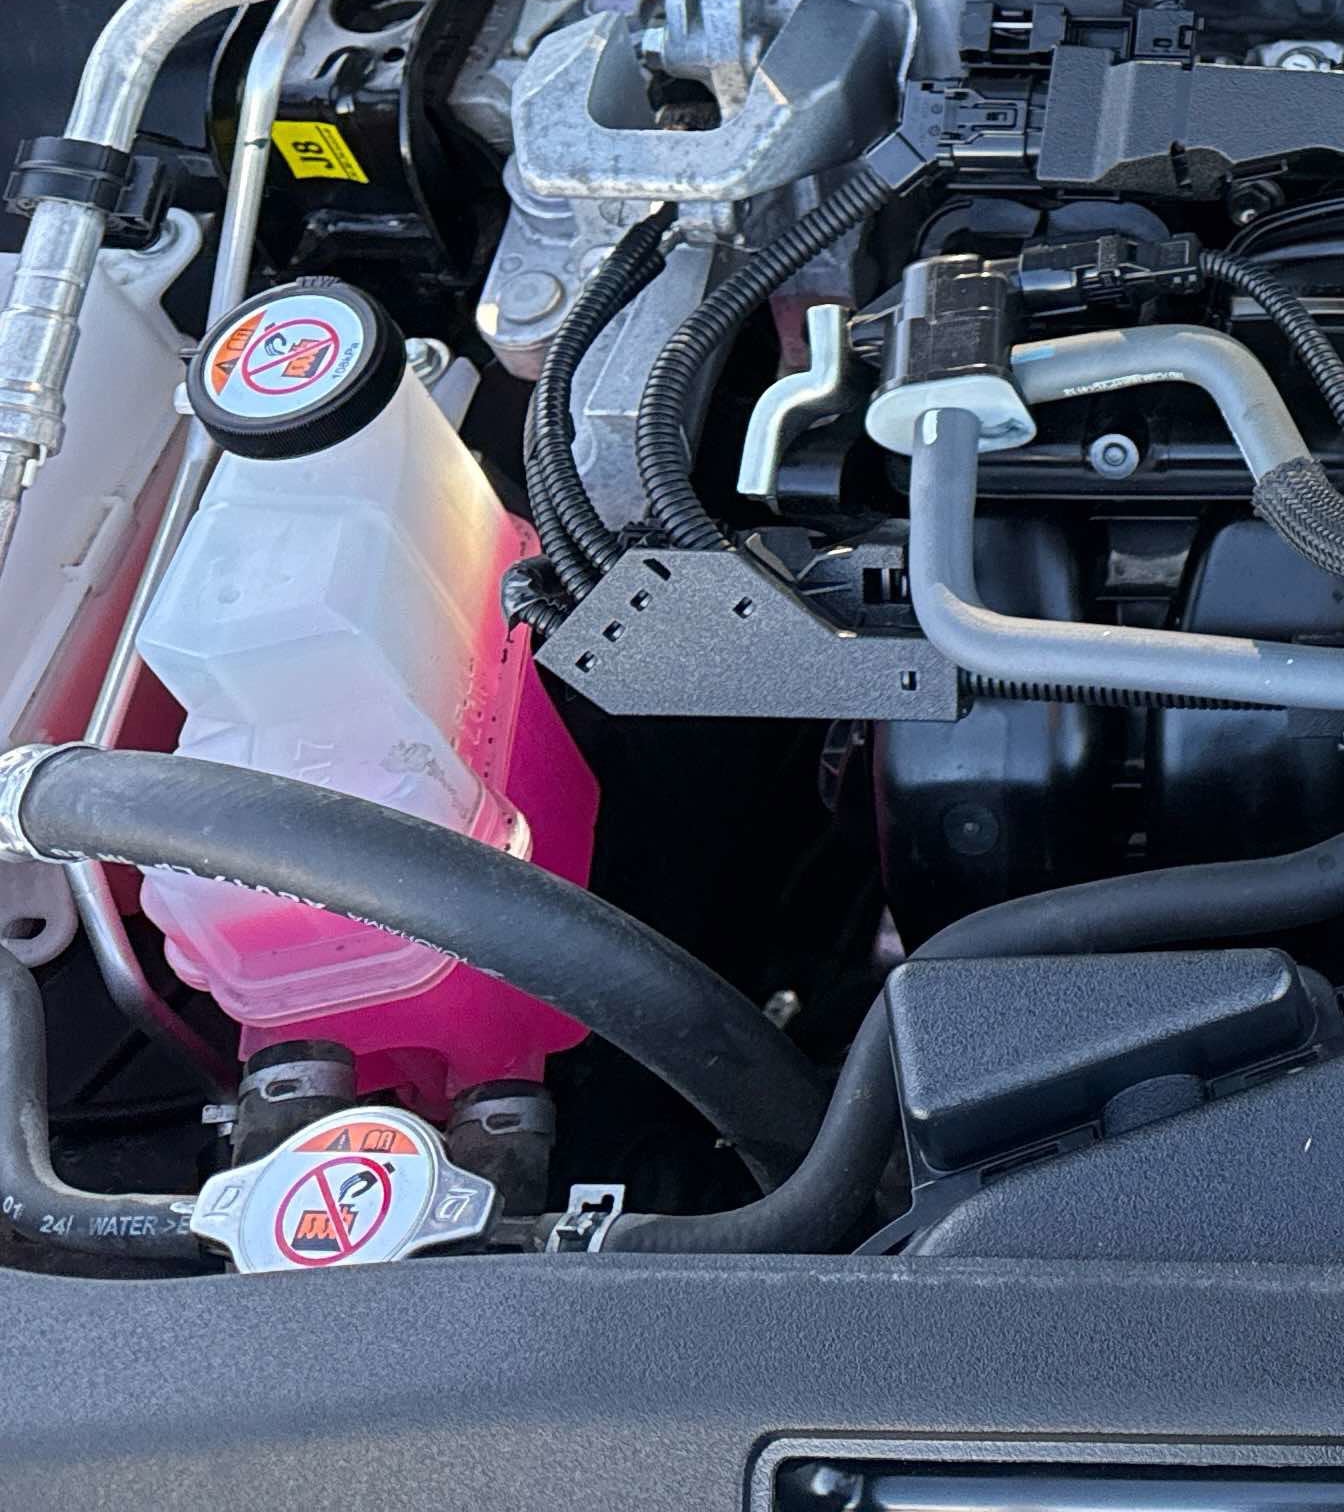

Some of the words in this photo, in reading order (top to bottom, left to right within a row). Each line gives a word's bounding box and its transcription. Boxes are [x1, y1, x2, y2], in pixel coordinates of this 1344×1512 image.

[294, 140, 334, 171] J8
[332, 342, 361, 382] 108kPa
[88, 1215, 159, 1237] WATER
